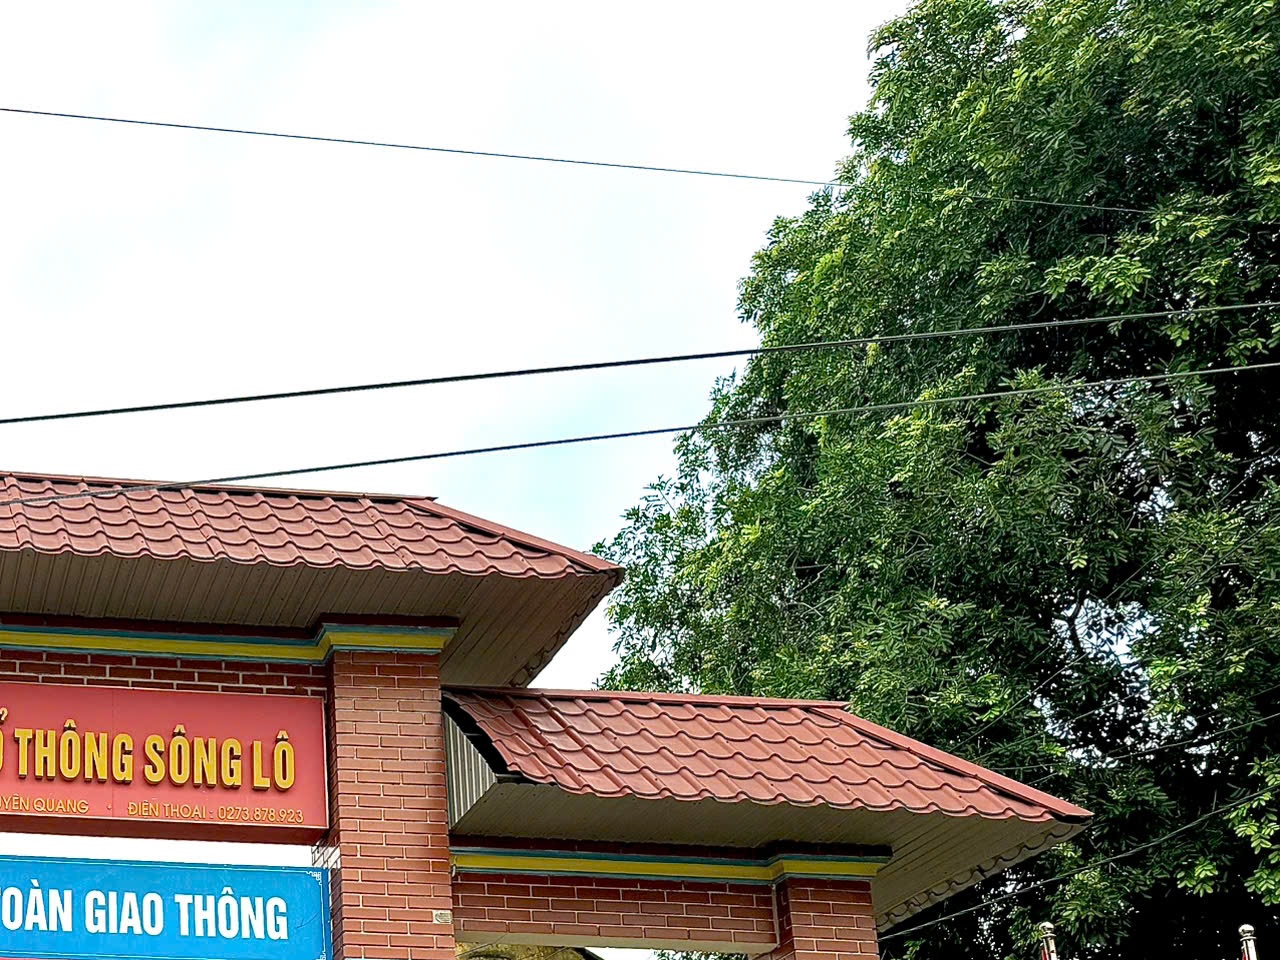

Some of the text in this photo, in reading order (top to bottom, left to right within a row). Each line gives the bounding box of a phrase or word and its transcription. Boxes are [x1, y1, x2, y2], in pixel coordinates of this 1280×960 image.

[14, 718, 134, 784] THÔNG
[144, 724, 242, 788] SÔNG
[252, 730, 296, 792] LÔ
[84, 889, 164, 936] GIAO
[174, 887, 289, 940] THÔNG
